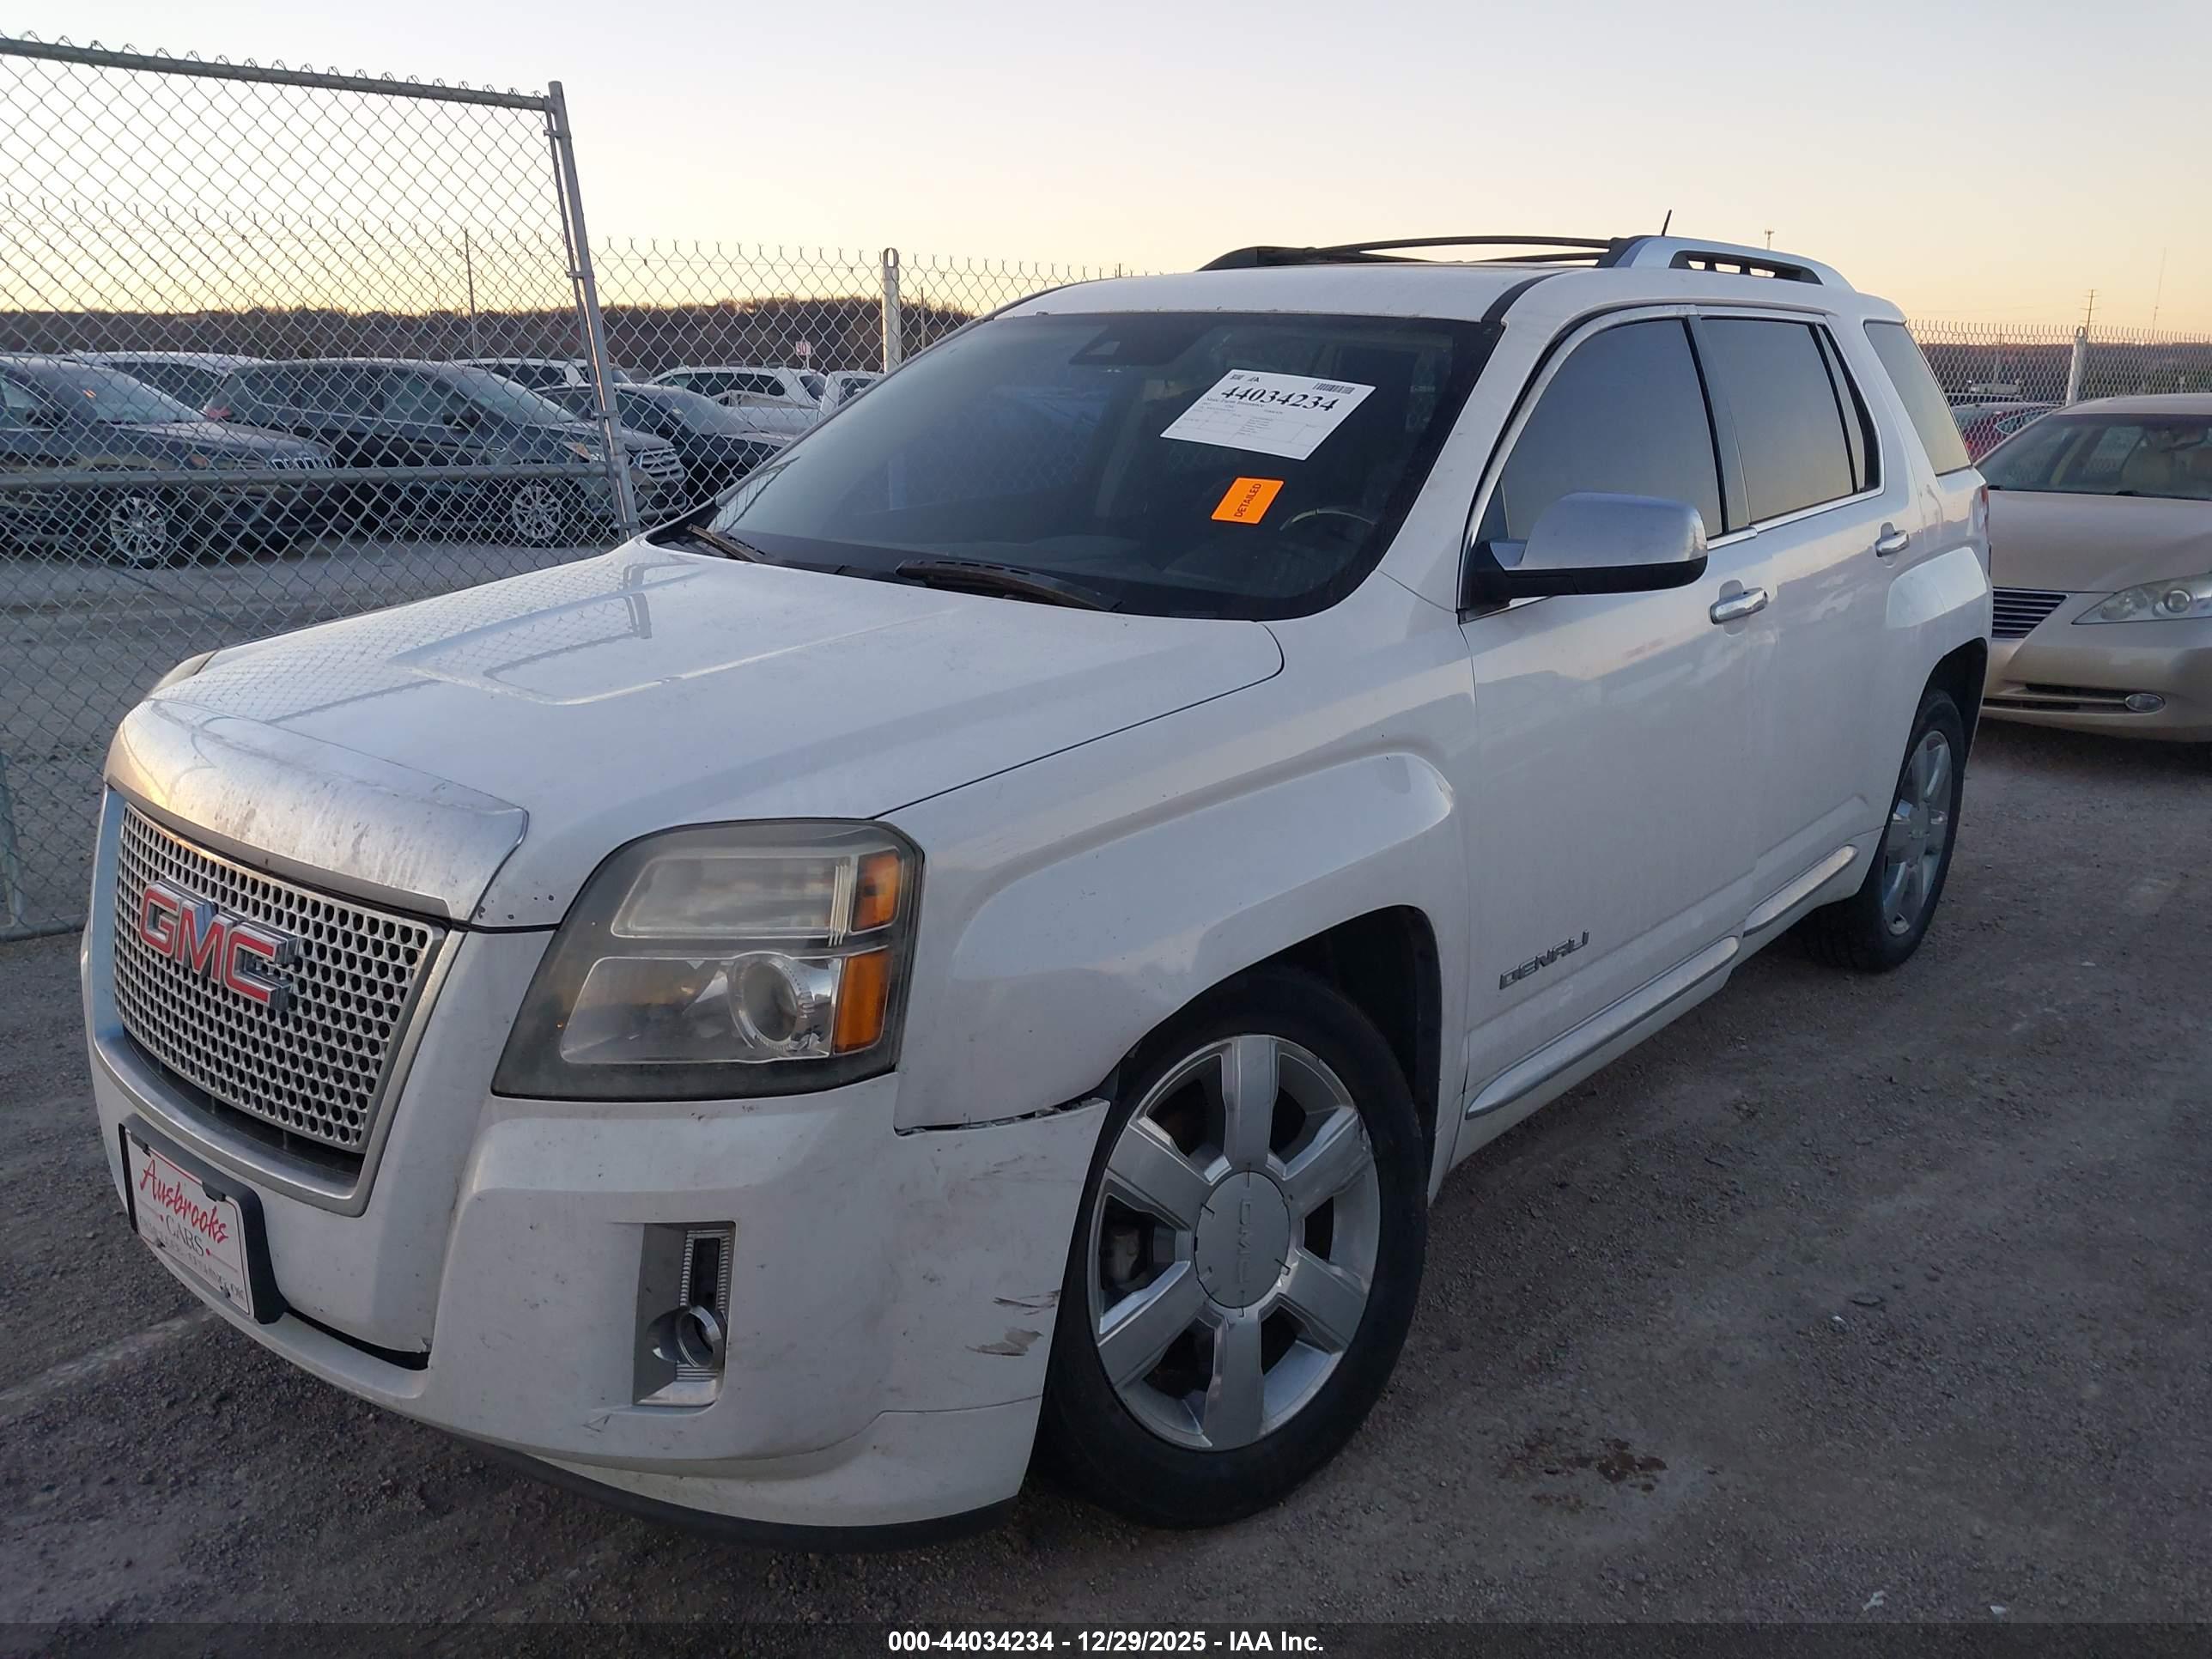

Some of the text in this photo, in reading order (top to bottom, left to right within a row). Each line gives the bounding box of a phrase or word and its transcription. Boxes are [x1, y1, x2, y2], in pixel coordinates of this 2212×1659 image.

[1221, 386, 1340, 412] 44034234
[1234, 483, 1262, 517] DETAILED
[139, 881, 289, 1009] GMC
[1498, 930, 1589, 989] DENALI
[140, 1159, 228, 1243] Ausbrooks
[166, 1214, 204, 1257] CARS
